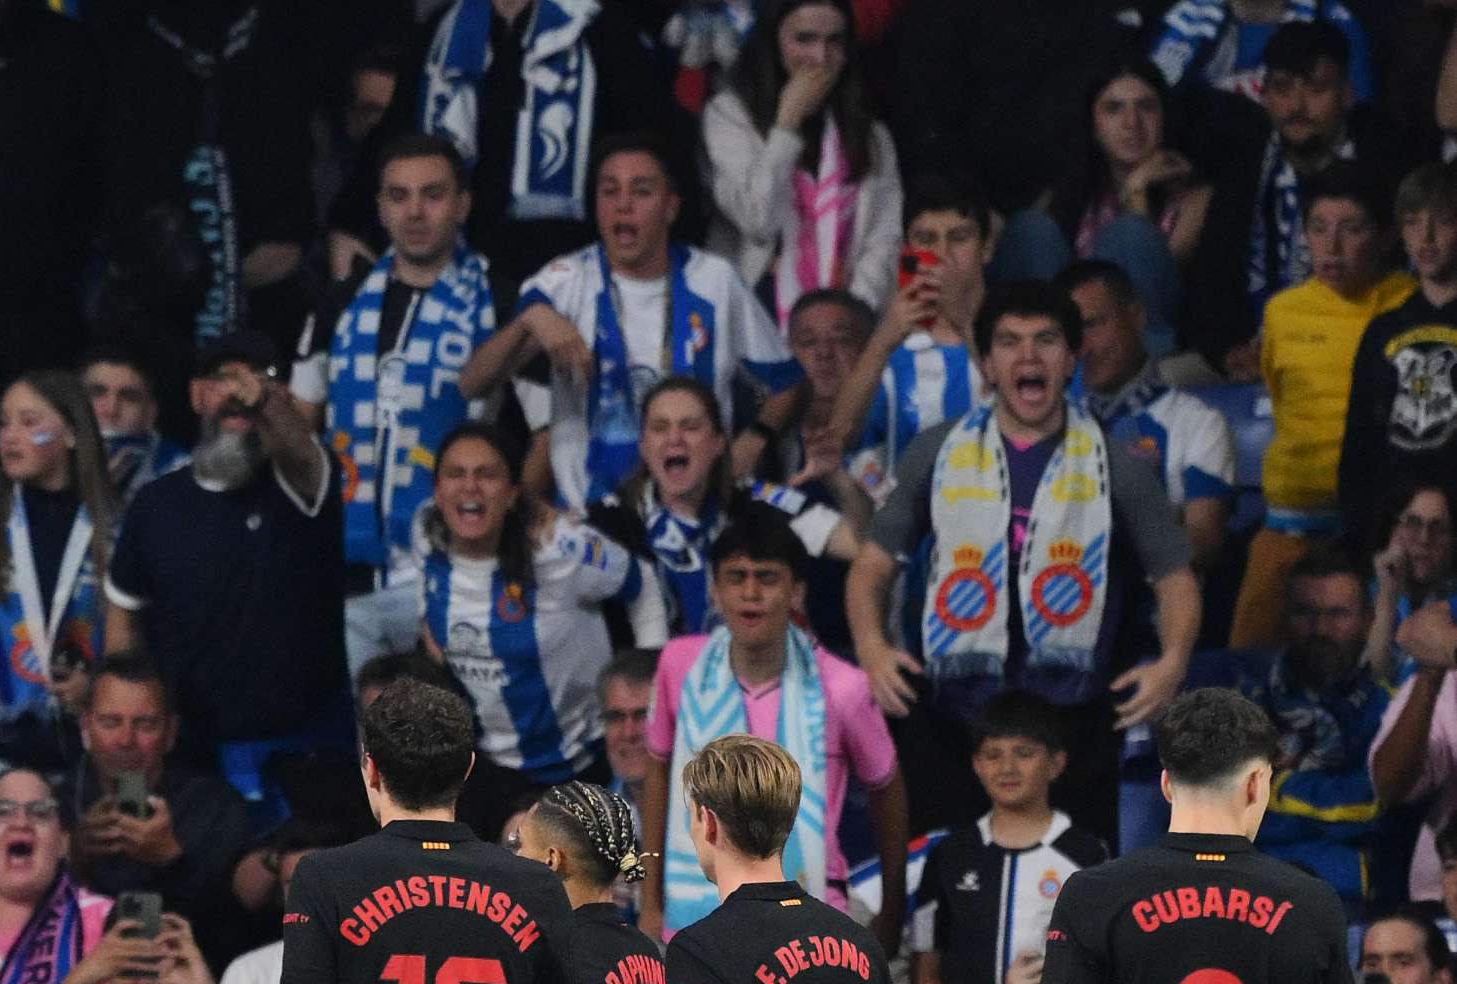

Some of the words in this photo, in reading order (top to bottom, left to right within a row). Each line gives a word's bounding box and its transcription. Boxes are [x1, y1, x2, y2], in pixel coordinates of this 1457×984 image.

[340, 874, 541, 954] CHRISTENSEN
[1132, 885, 1294, 935] CUBARSÍ
[774, 939, 810, 978] DE
[808, 935, 871, 980] JONG
